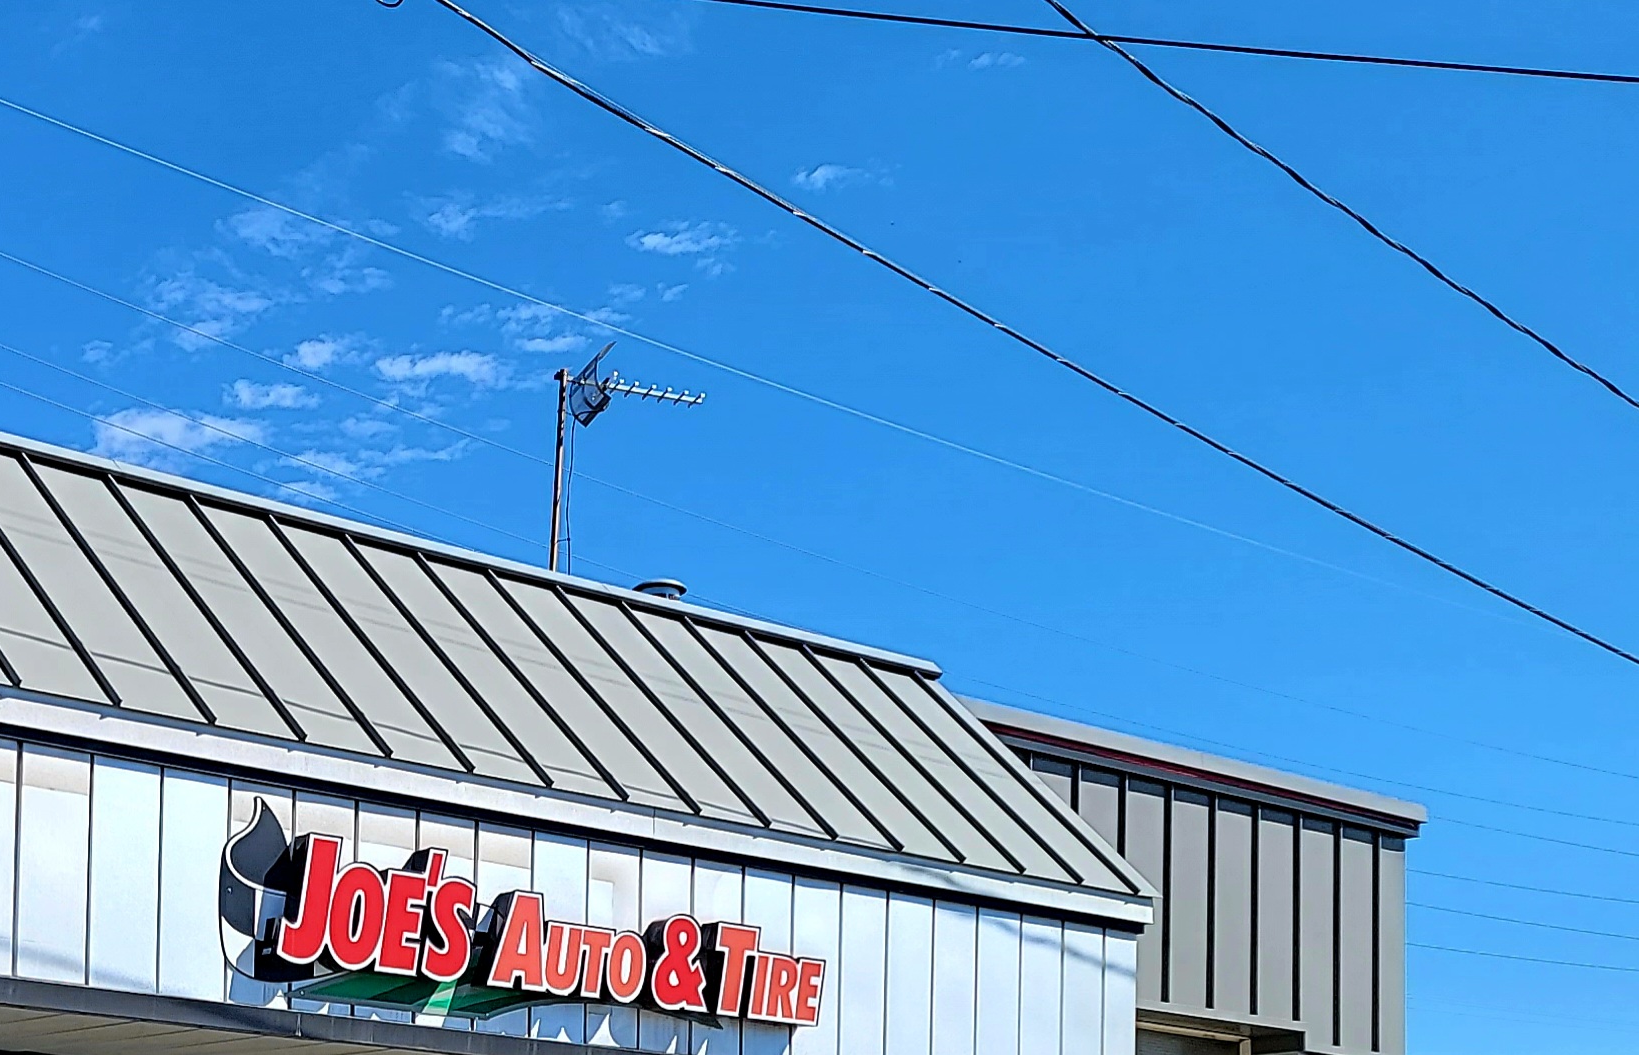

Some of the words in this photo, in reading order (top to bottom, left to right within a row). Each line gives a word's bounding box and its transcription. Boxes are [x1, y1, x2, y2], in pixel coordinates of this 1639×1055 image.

[277, 832, 476, 982] JOE'S
[487, 891, 647, 1001] AUTO
[651, 914, 707, 1012] &
[716, 922, 827, 1028] TIRE
